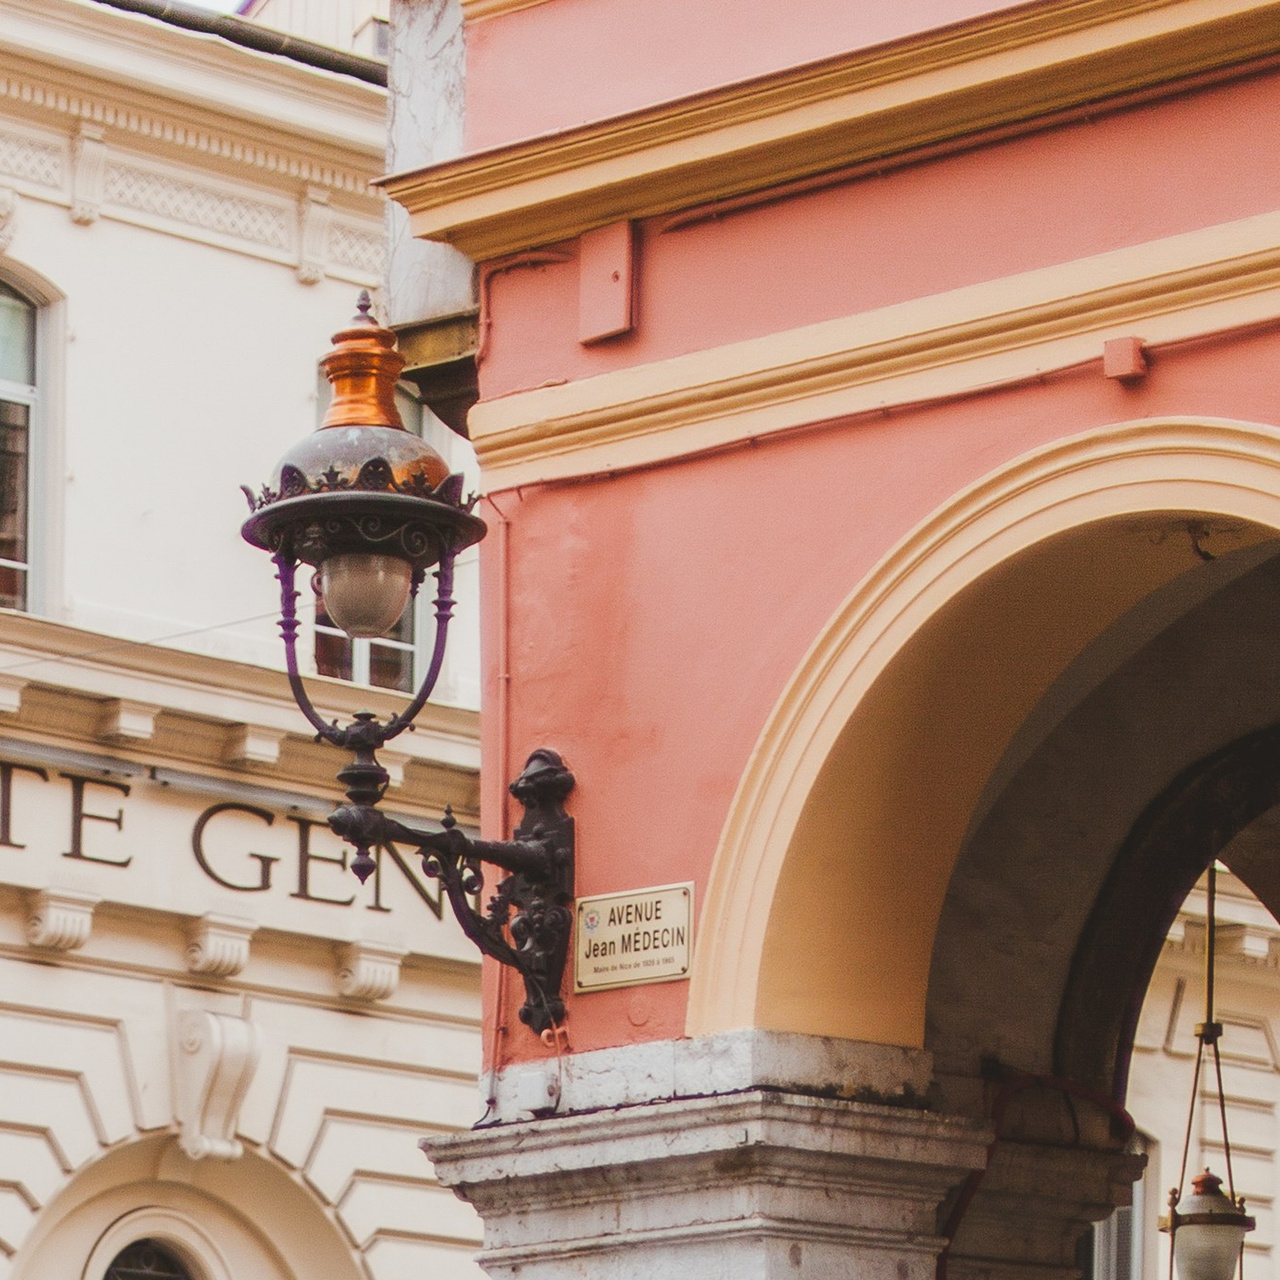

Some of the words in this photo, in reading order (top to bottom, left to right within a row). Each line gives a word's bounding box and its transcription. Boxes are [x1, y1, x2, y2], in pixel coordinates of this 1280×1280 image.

[192, 802, 480, 921] GEN
[608, 900, 662, 926] AVENUE
[585, 938, 616, 959] Jean
[621, 926, 685, 953] MÉDECIN
